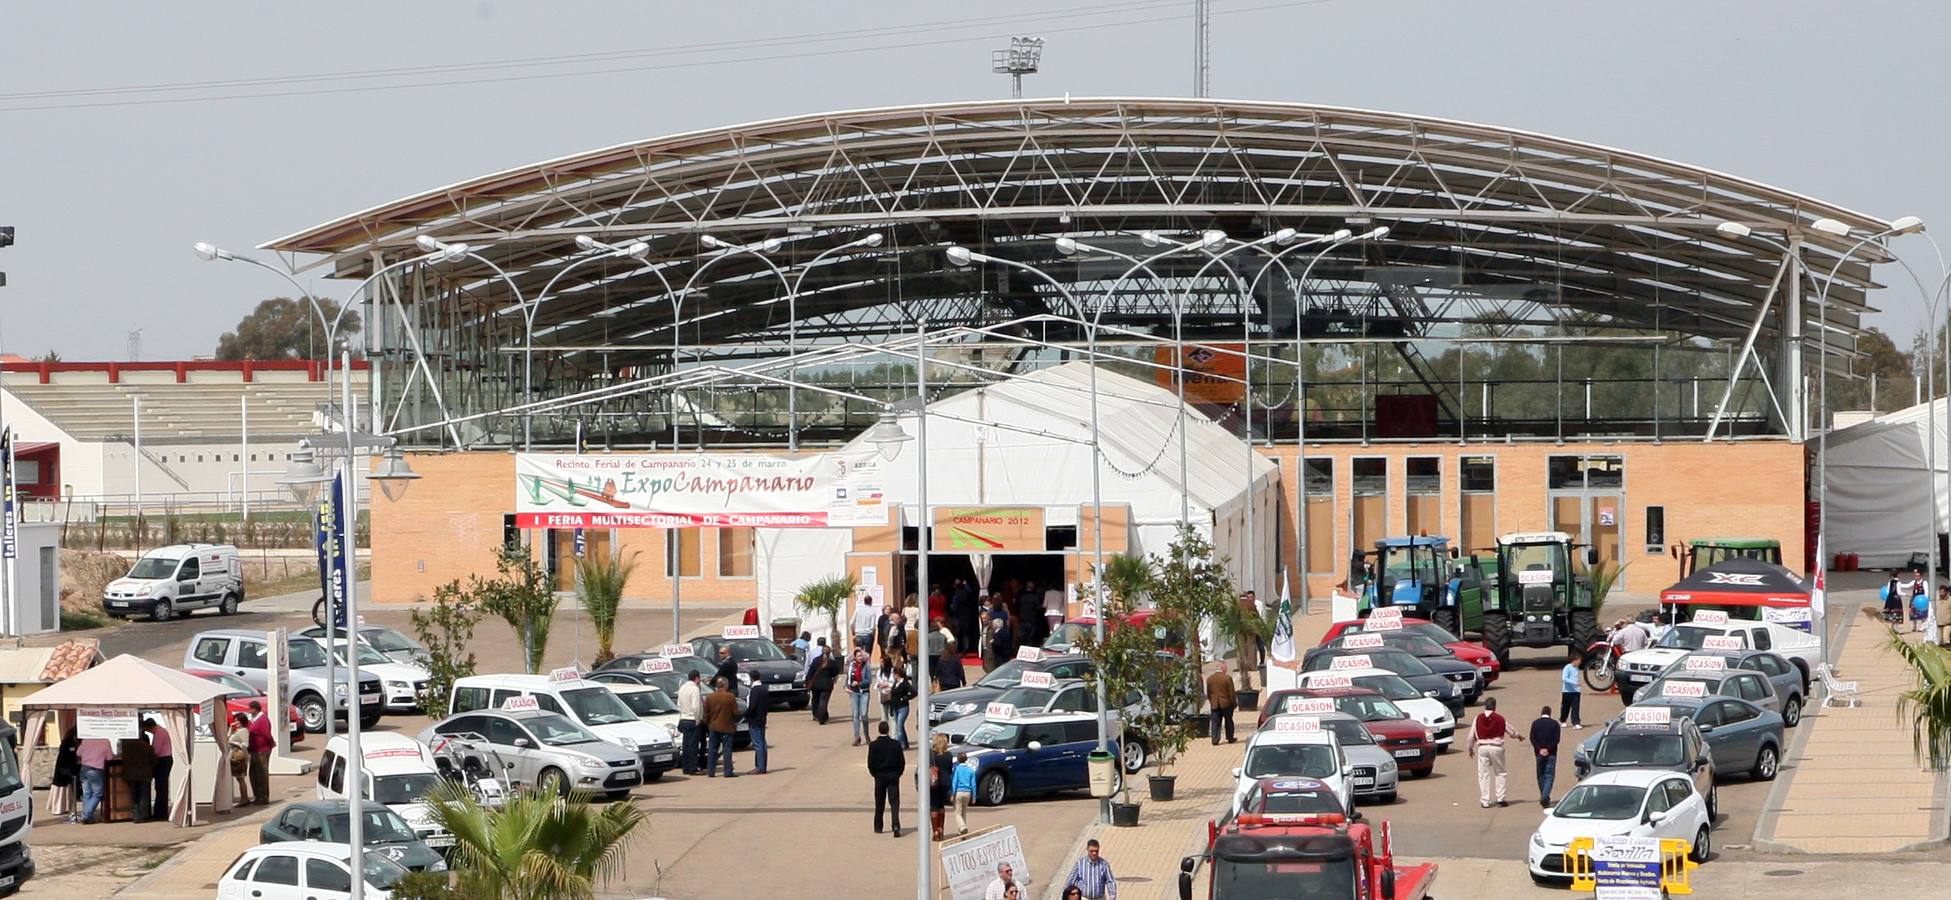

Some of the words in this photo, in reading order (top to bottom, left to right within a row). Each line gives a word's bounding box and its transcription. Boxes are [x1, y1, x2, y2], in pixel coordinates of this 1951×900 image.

[556, 459, 590, 469] Recinto
[595, 459, 620, 469] Ferial
[625, 460, 637, 469] de
[641, 460, 696, 471] Campanario
[701, 459, 712, 468] 24
[716, 461, 722, 470] y
[726, 459, 737, 468] 25
[742, 459, 753, 468] de
[758, 460, 787, 468] marzo
[548, 515, 584, 526] FERIA
[592, 515, 694, 526] MULTISECTORIAL
[703, 515, 720, 526] DE
[728, 515, 811, 526] CAMPANARIO
[953, 516, 1003, 525] CAMPANARIO
[1007, 517, 1029, 525] 2012
[3, 511, 15, 557] talleres
[1520, 573, 1553, 583] OCASION
[1376, 609, 1401, 618] OCASION
[1695, 613, 1726, 623] OCASION
[1369, 620, 1401, 629] OCASION
[1348, 637, 1382, 647] OCASION
[1705, 638, 1740, 649] OCASION
[666, 645, 692, 656] OCASION
[646, 659, 672, 671] OCASION
[1337, 659, 1371, 669] OCASION
[1688, 659, 1724, 670] OCASION
[557, 670, 579, 681] OCASION
[1023, 673, 1049, 685] OCASION
[1313, 676, 1350, 687] OCASION
[1664, 685, 1703, 695] OCASION
[510, 695, 538, 708] OCASION
[1291, 702, 1333, 712] OCASION
[1627, 711, 1669, 722] OCASION
[1277, 721, 1319, 732] OCASION
[1599, 845, 1655, 860] Sevilla
[948, 850, 977, 879] AUTOS
